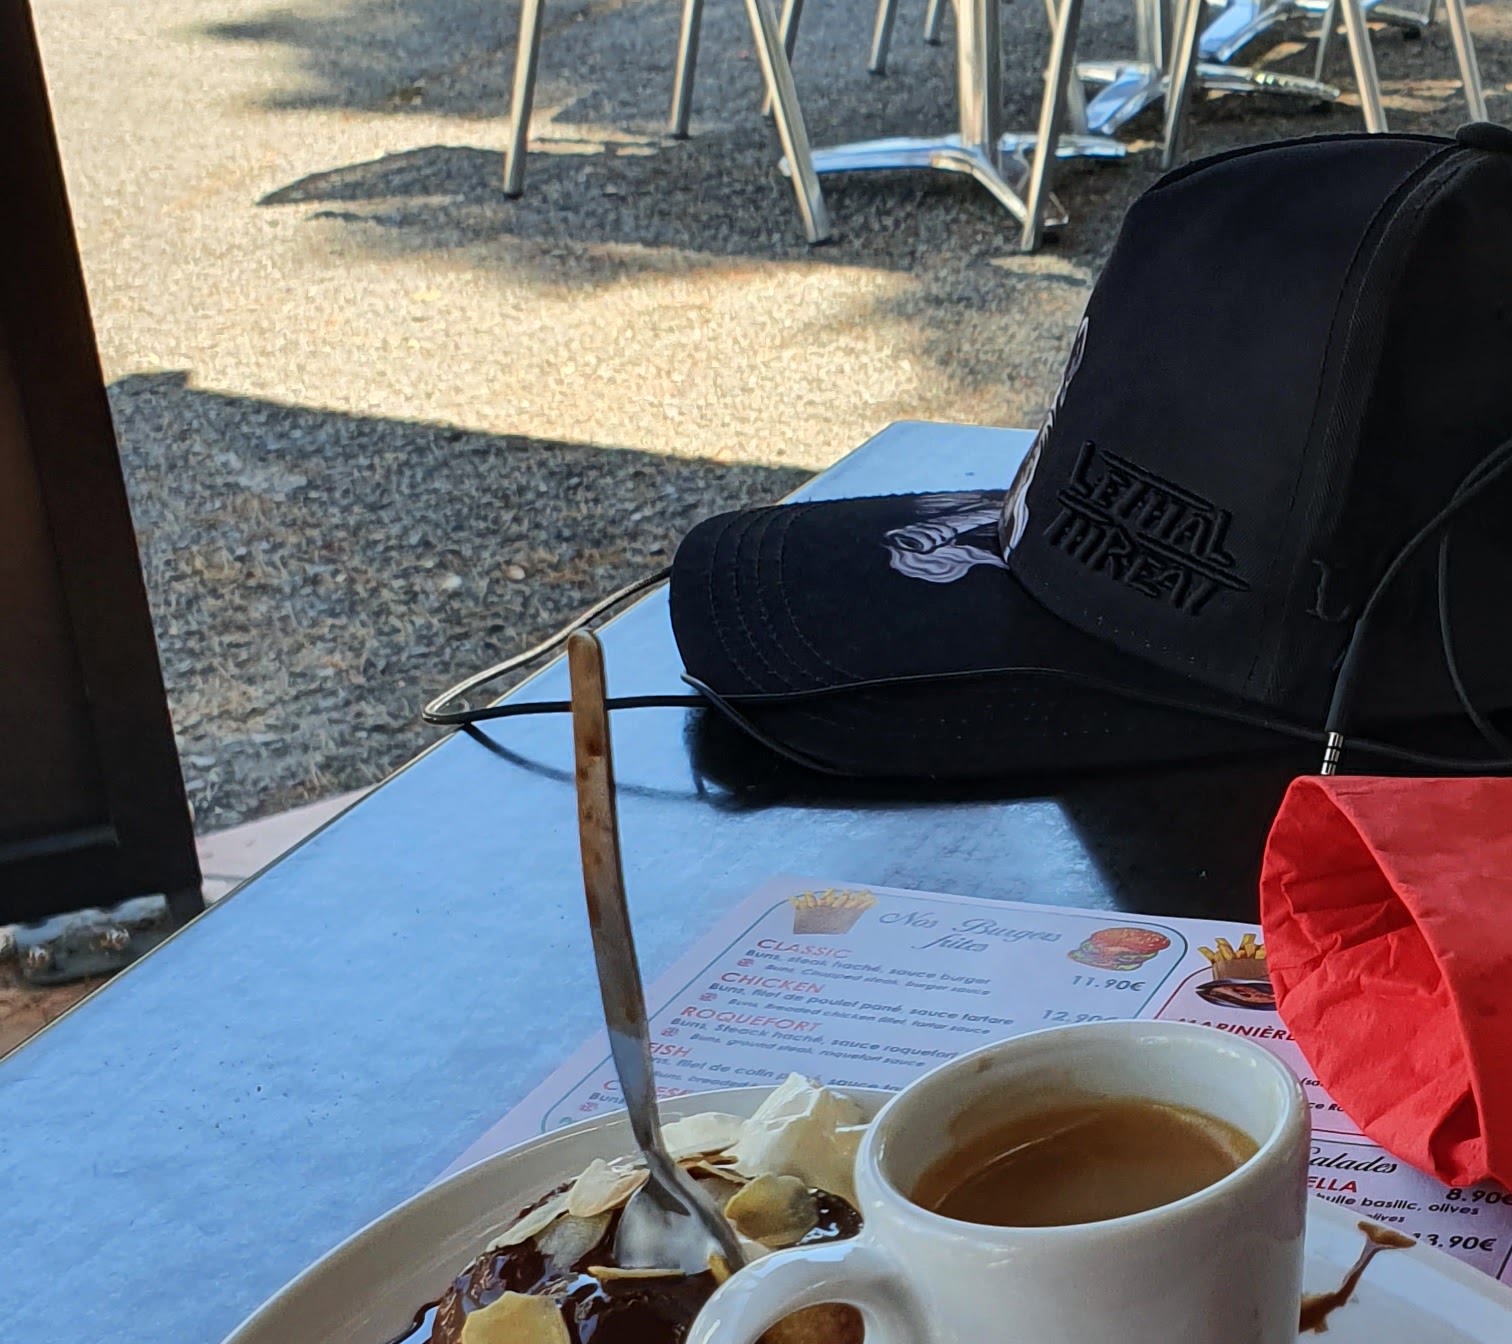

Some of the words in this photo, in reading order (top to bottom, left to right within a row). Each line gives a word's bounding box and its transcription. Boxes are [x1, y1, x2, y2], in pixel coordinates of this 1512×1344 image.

[756, 939, 853, 960] CLASSIC
[719, 971, 826, 994] CHICKEN
[1071, 975, 1146, 992] 11.90€
[680, 1006, 822, 1033] ROQUEFORT
